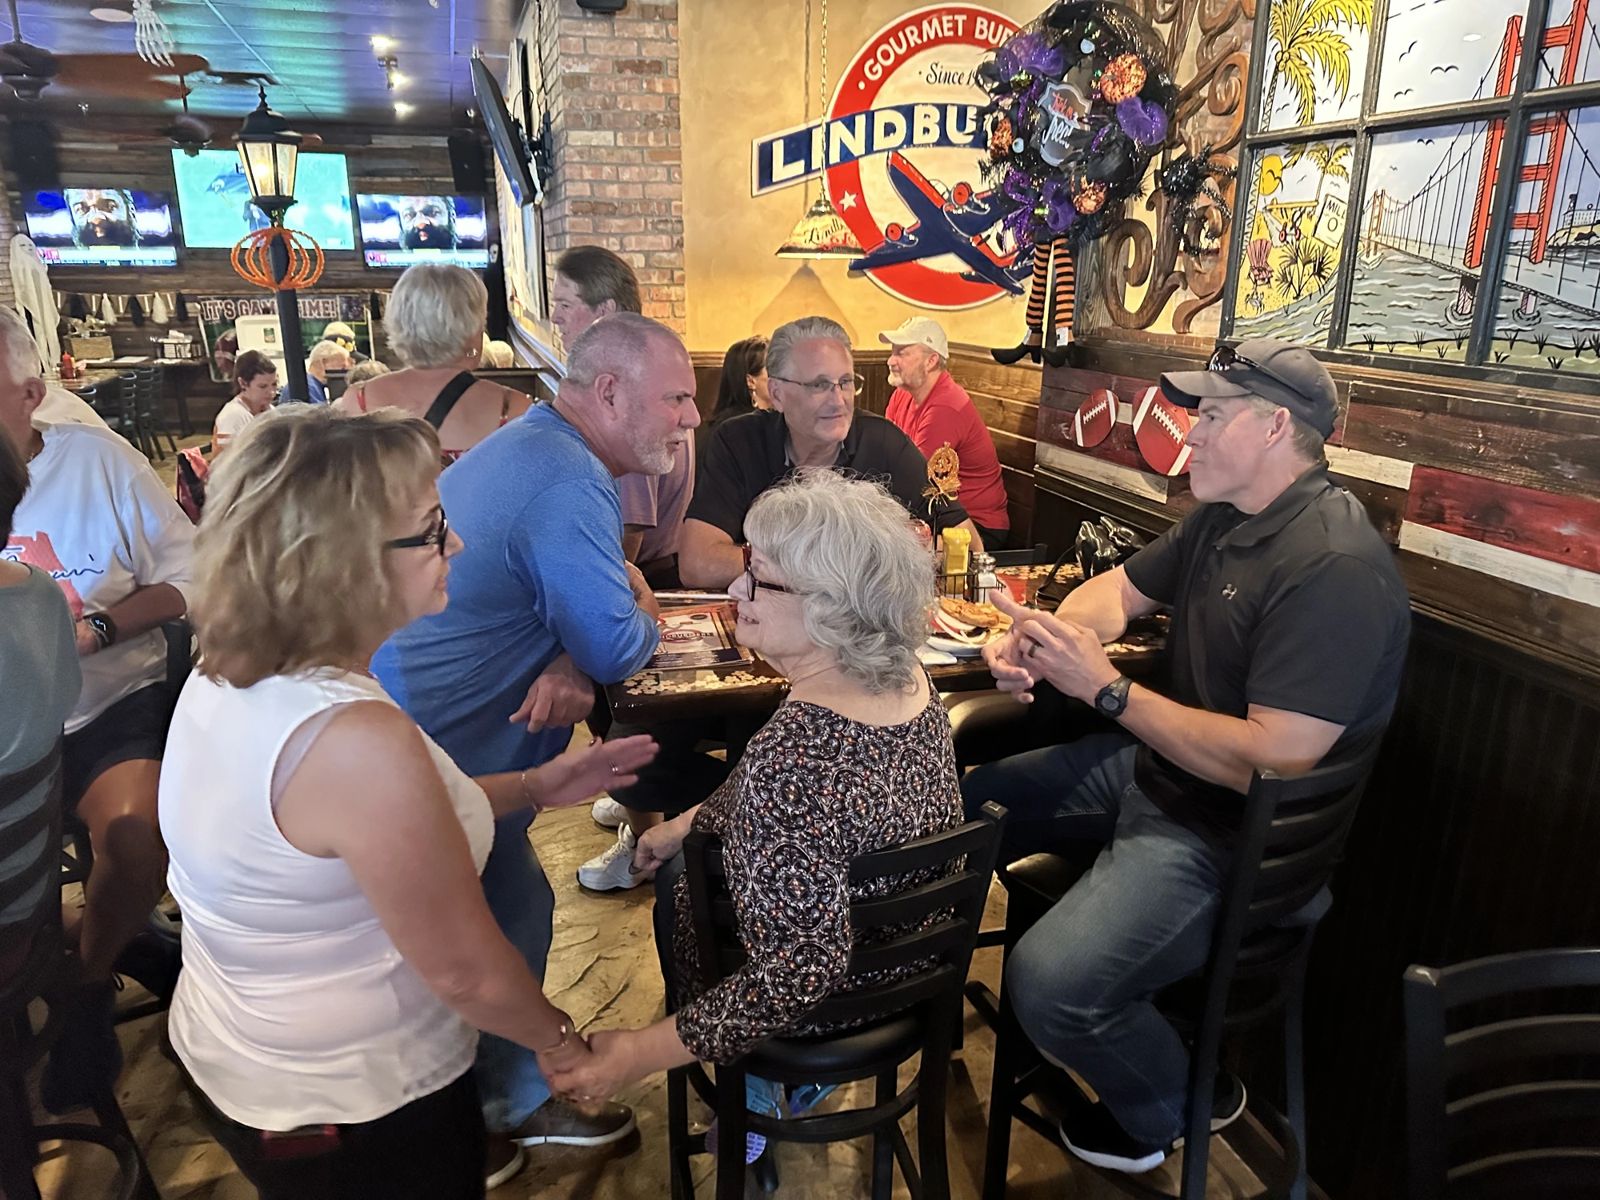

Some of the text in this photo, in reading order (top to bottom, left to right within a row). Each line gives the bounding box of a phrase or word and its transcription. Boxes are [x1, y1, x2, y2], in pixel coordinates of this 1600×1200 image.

[863, 14, 967, 81] GOURMET
[926, 61, 965, 85] Since
[771, 104, 978, 182] LINDBU
[201, 298, 337, 320] IT'S GAM IME!
